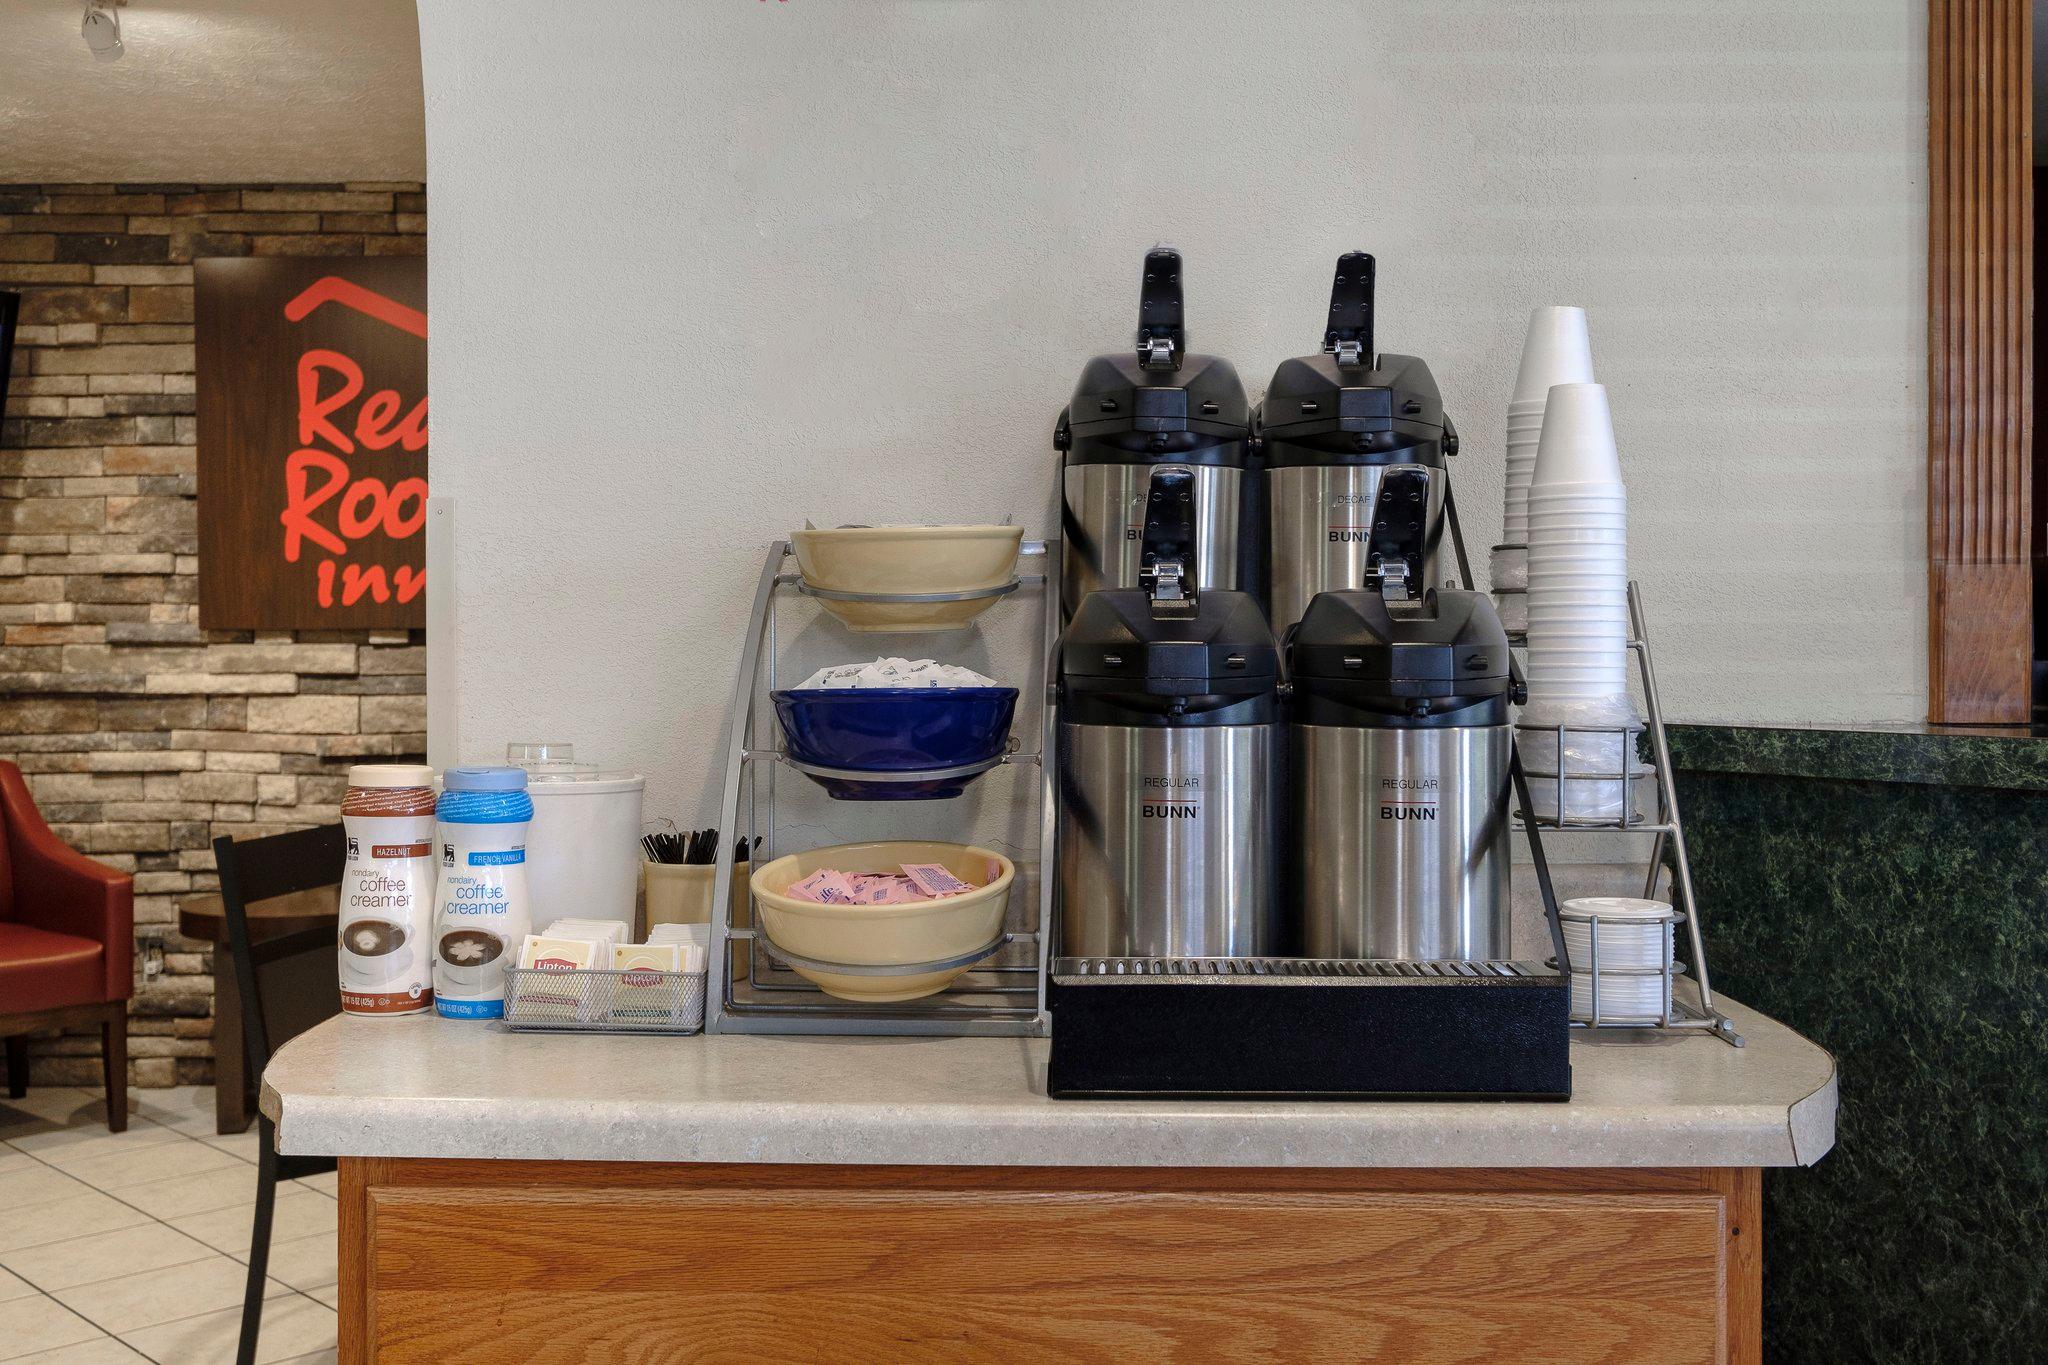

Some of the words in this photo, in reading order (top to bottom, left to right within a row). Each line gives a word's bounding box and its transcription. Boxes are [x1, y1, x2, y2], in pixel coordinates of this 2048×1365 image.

[1337, 495, 1371, 504] DECAF
[280, 449, 428, 563] Roo
[1144, 777, 1200, 788] REGULAR
[1381, 779, 1439, 790] REGULAR
[1142, 805, 1197, 819] BUNN
[1380, 806, 1436, 820] BUNN
[376, 847, 412, 856] HAZELNUT
[473, 855, 501, 864] FRENCH
[351, 868, 380, 878] nondairy
[359, 876, 406, 892] coffee
[446, 875, 478, 886] nondairy
[456, 884, 504, 899] coffee
[350, 894, 410, 908] creamer
[446, 901, 510, 915] creamer
